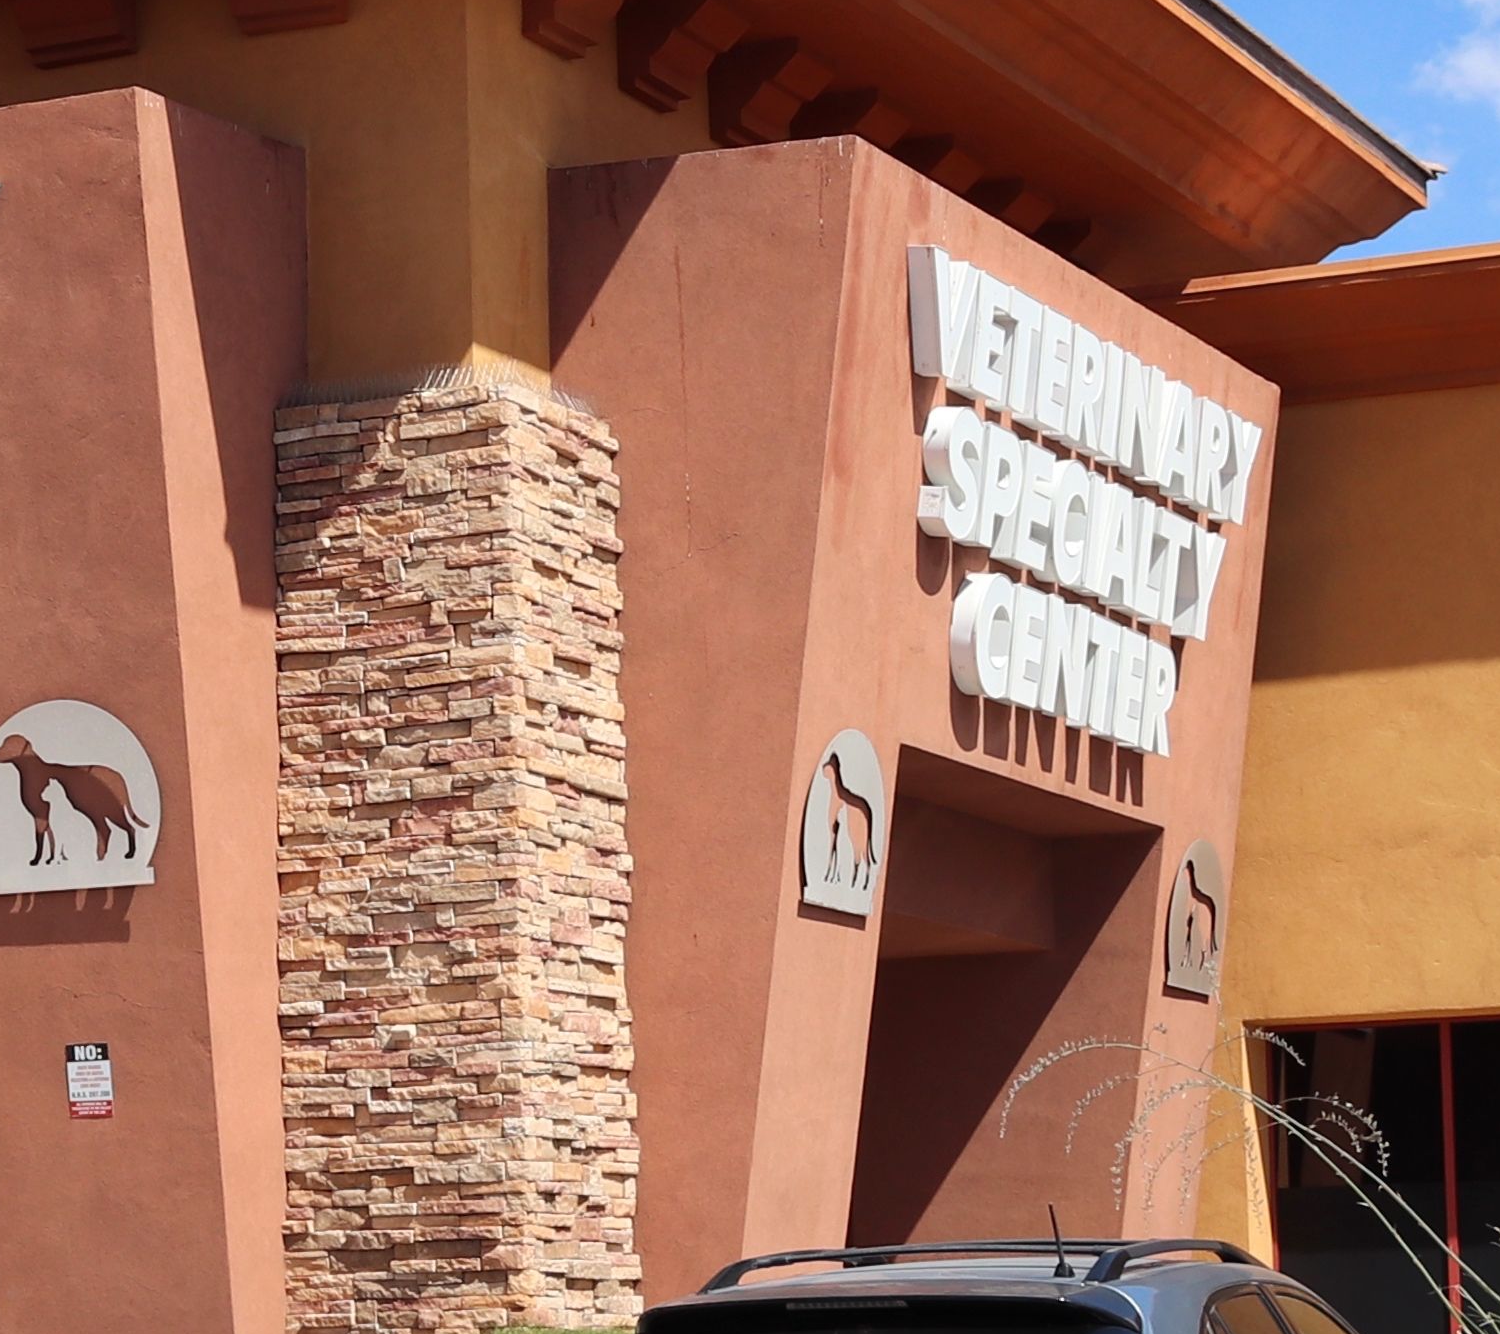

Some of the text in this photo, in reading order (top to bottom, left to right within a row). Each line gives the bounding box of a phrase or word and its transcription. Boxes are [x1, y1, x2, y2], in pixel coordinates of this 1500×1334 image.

[907, 245, 1262, 526] VETERINARY
[917, 406, 1227, 640] SPECIALTY
[950, 573, 1177, 757] CENTER
[74, 1045, 103, 1061] NO:
